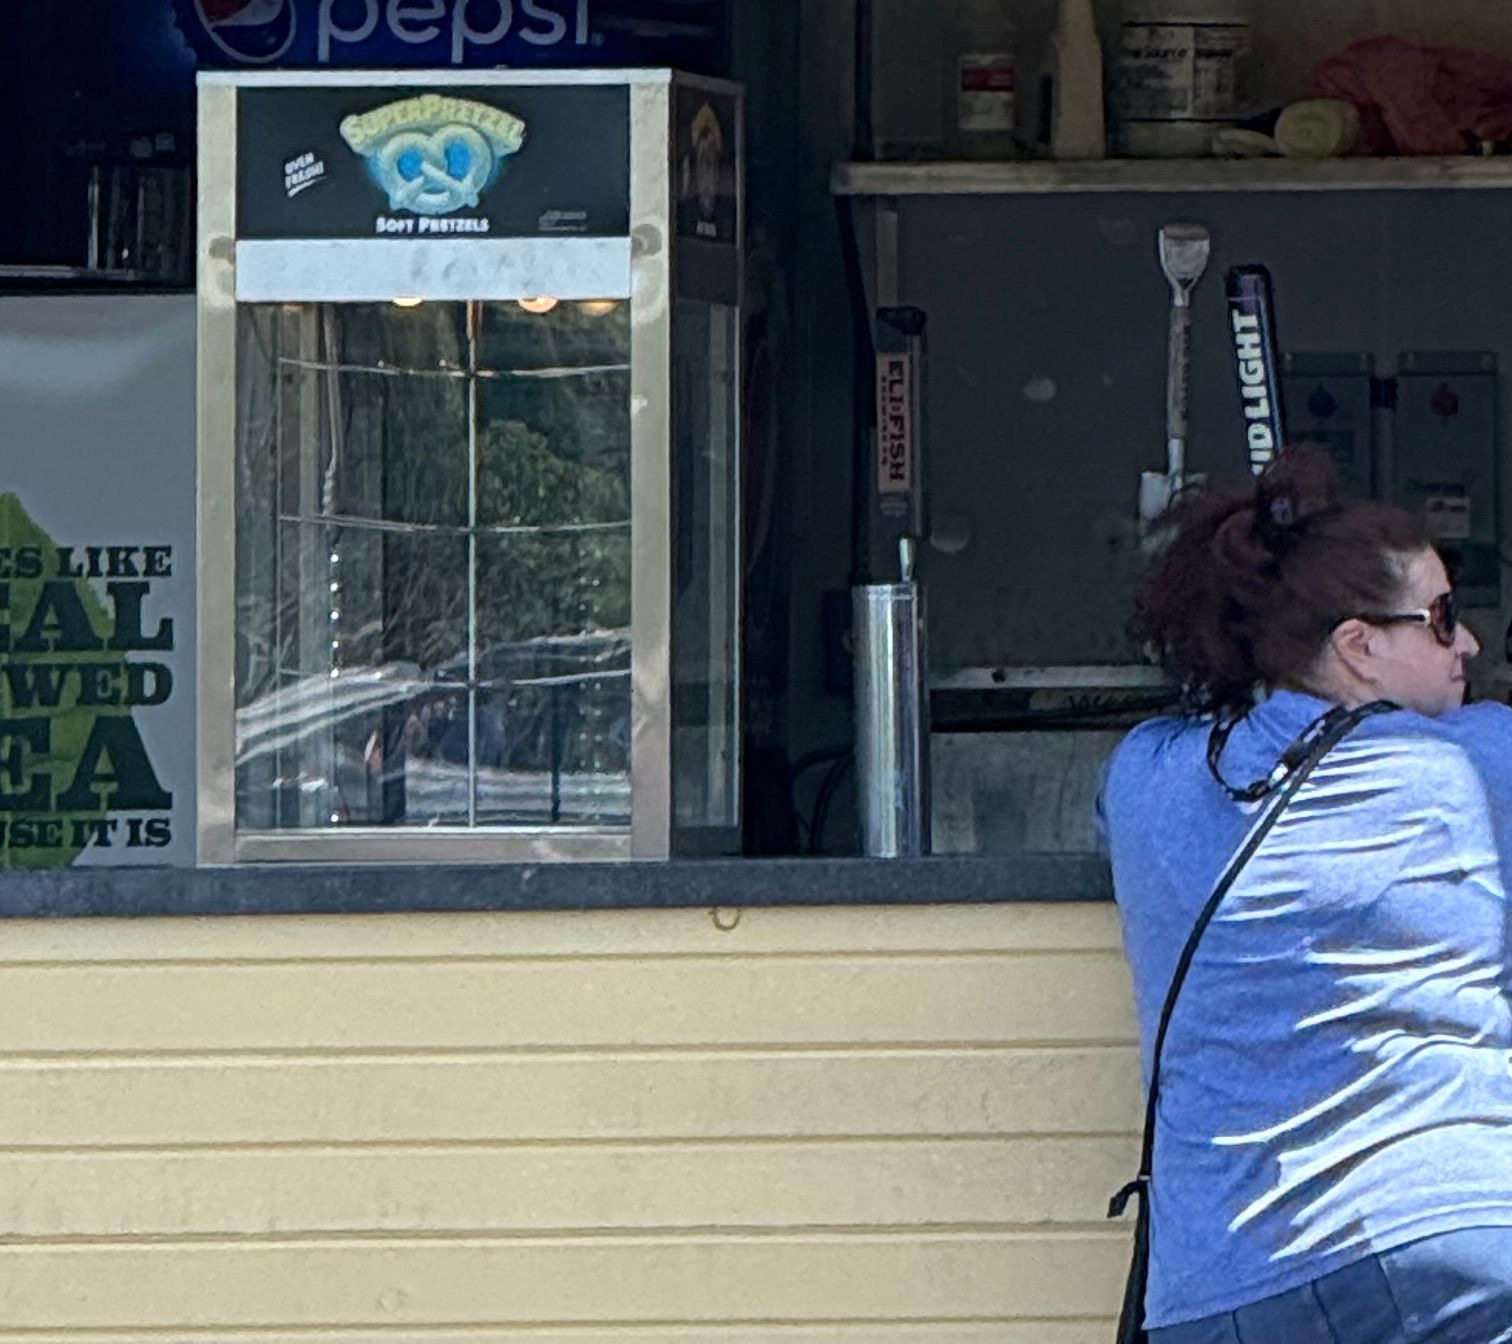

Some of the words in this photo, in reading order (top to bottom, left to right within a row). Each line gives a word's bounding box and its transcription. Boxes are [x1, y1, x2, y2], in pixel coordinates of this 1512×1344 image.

[1232, 308, 1271, 419] LIGHT
[57, 545, 172, 577] LIKE
[0, 582, 173, 651] AL
[71, 818, 118, 847] IT
[126, 818, 172, 848] IS
